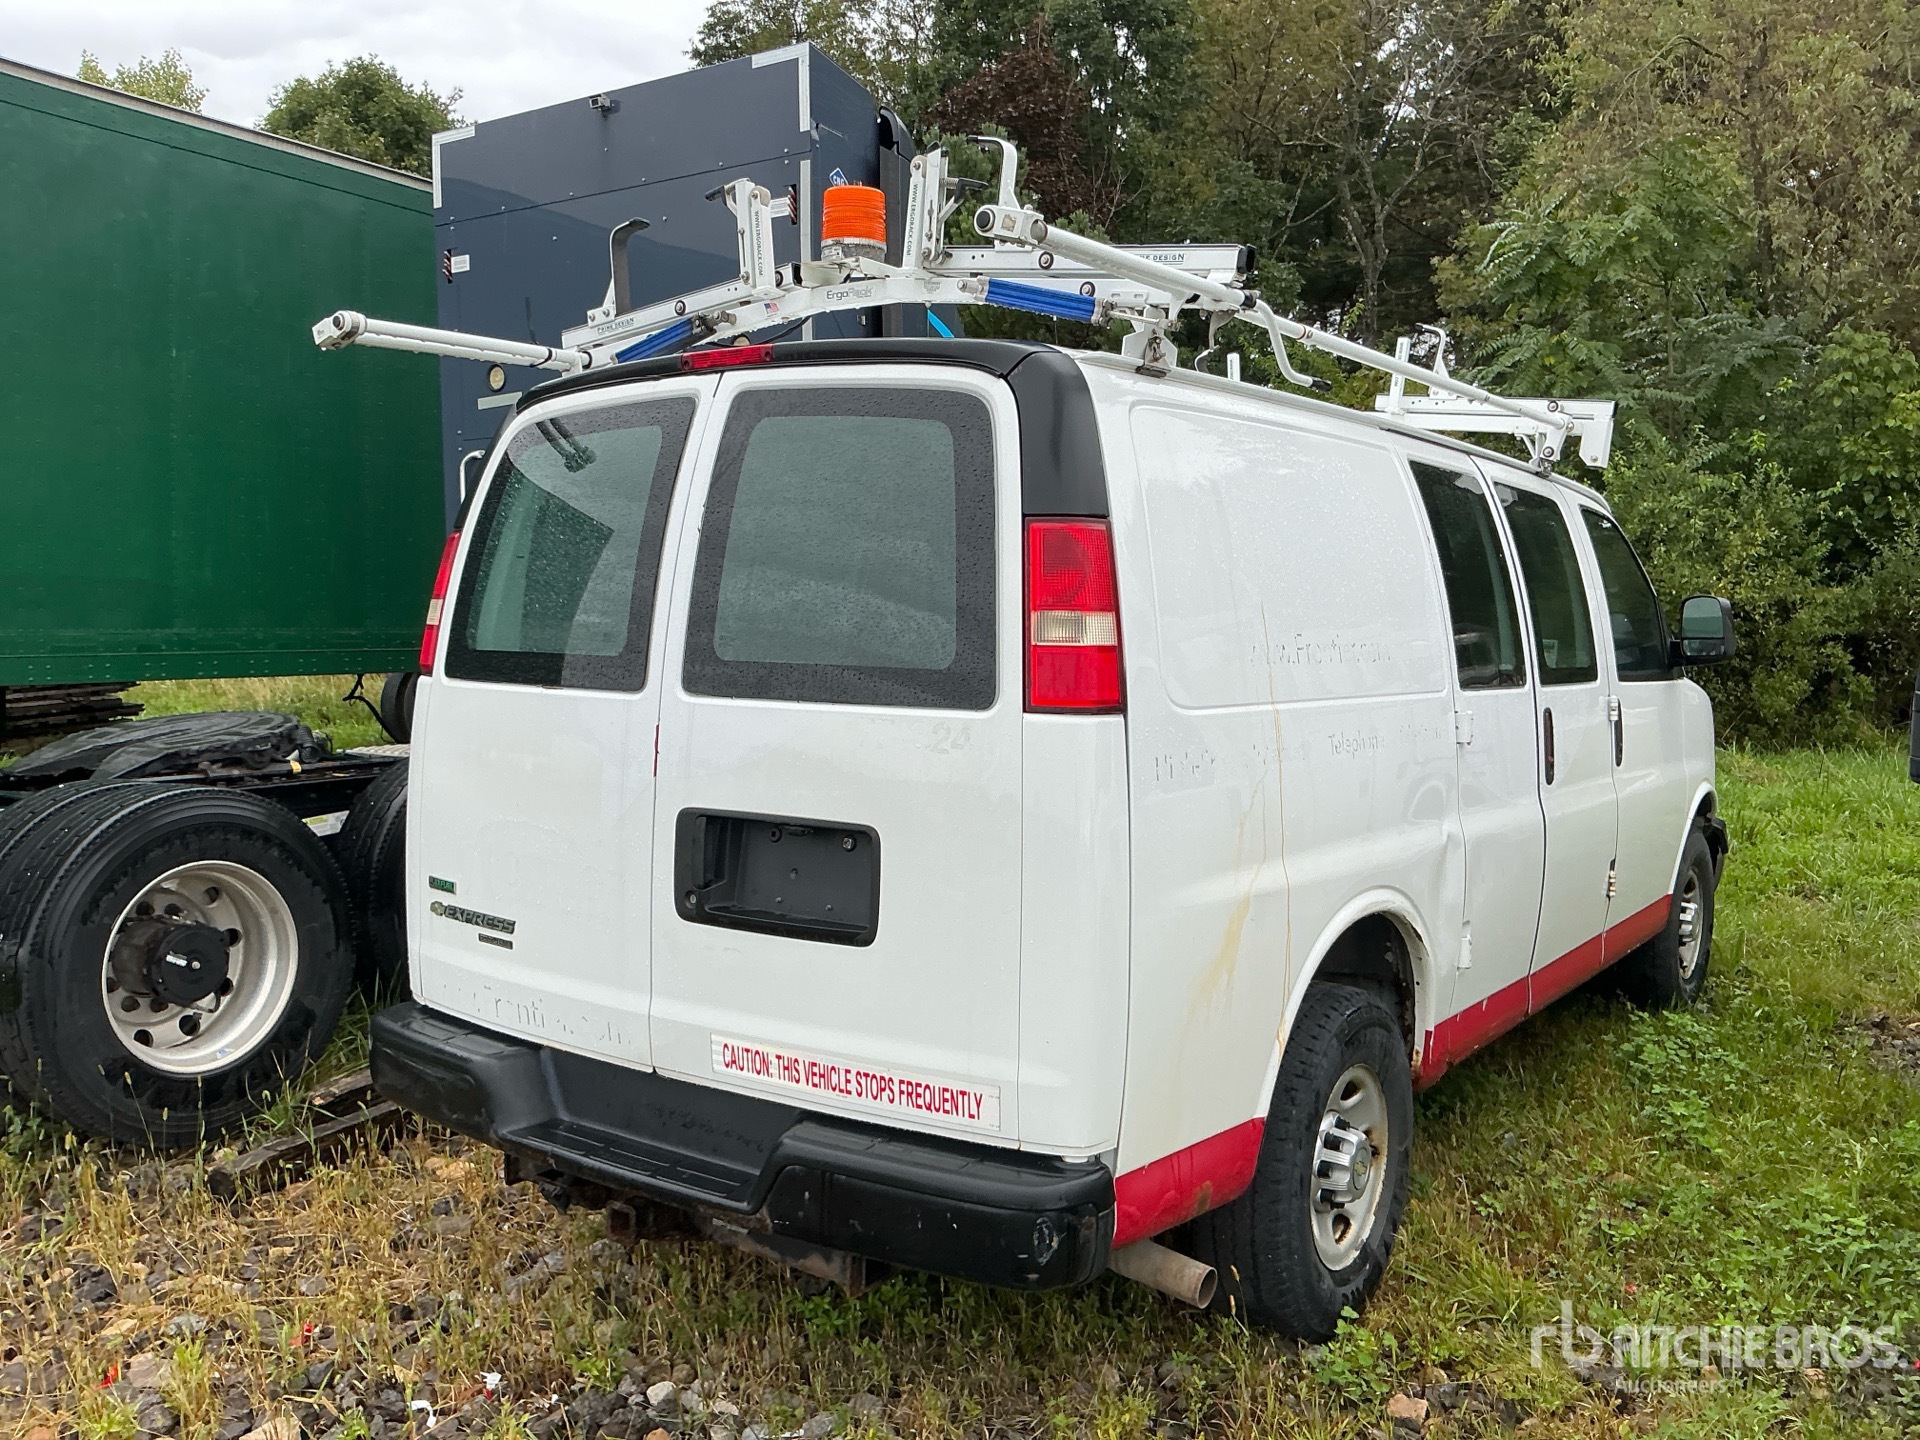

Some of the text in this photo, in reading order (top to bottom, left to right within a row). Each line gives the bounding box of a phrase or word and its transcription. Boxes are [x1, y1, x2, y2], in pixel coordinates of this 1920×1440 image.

[754, 210, 764, 276] WWW.ERGORACK.COM
[906, 183, 919, 256] WWW.ERGORACK.COM
[1152, 253, 1185, 261] DESIGN
[445, 905, 515, 933] EXPRESS
[722, 1043, 983, 1121] CAUTION: THIS VEHICLE STOPS FREQUENTLY
